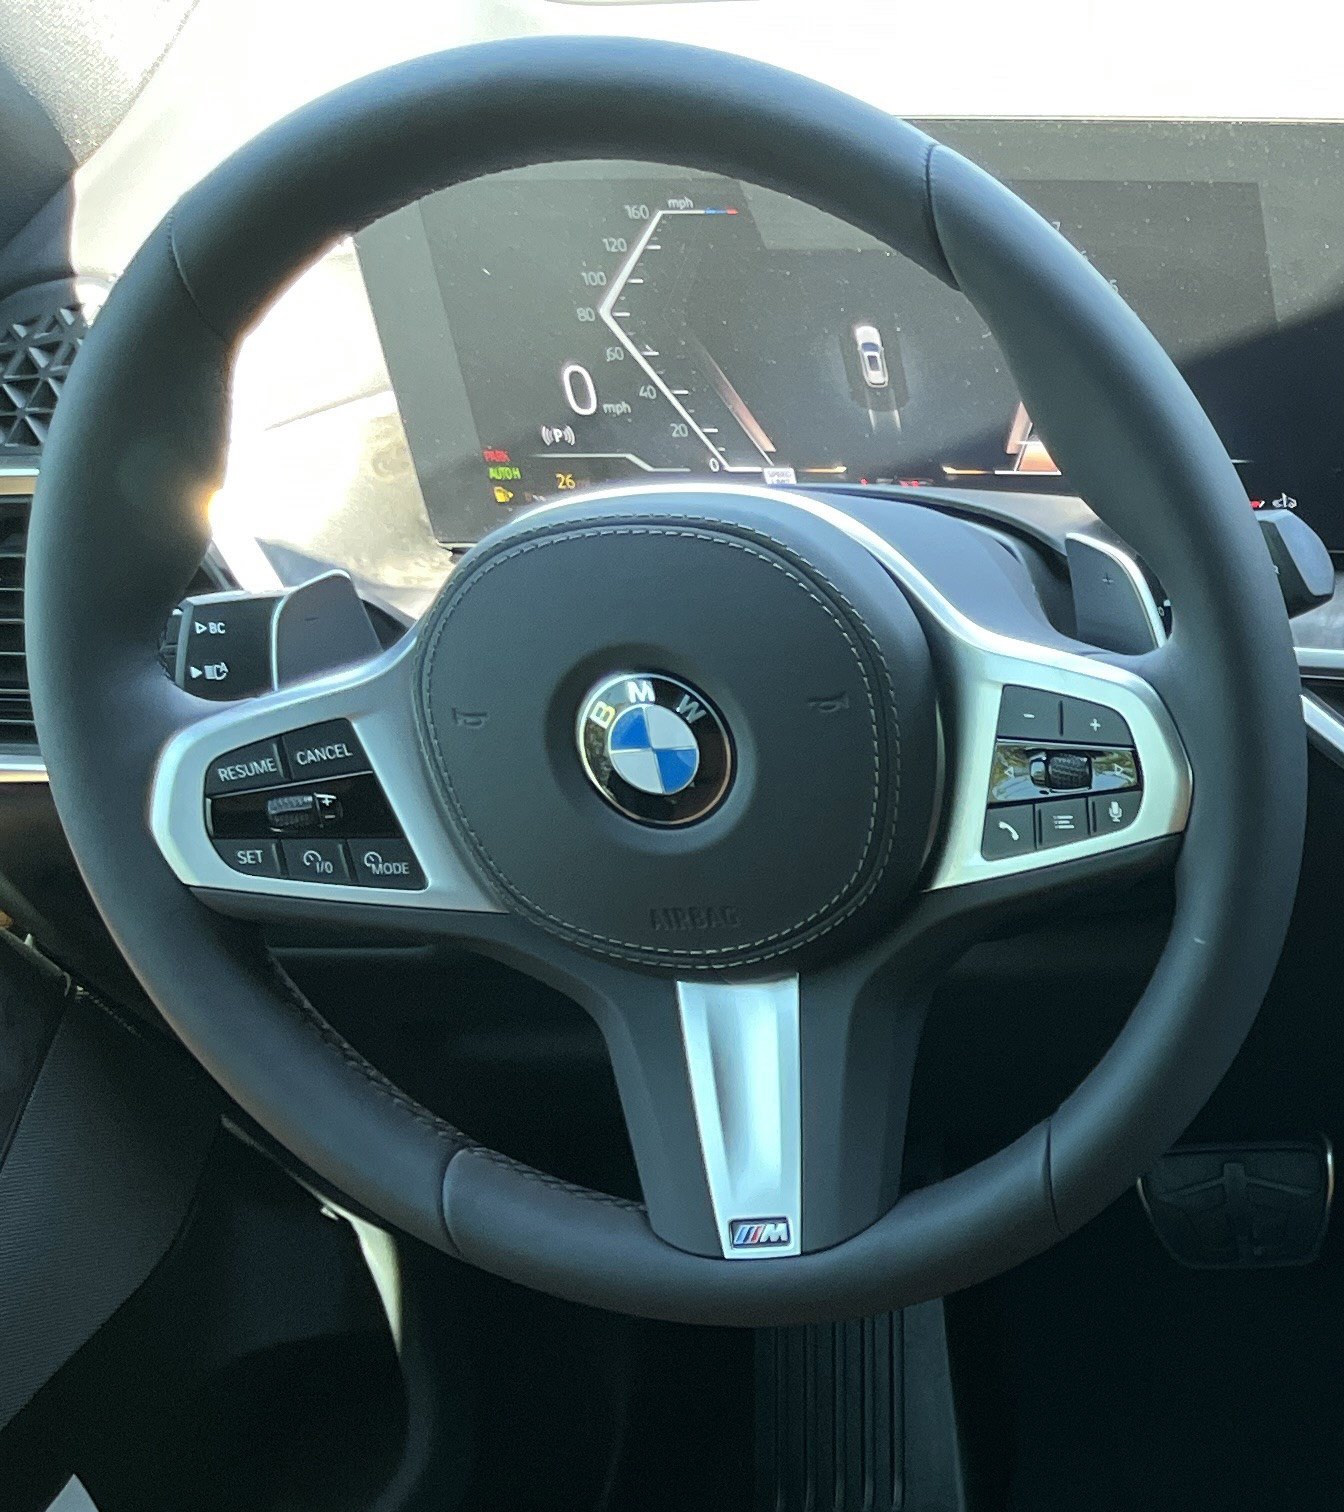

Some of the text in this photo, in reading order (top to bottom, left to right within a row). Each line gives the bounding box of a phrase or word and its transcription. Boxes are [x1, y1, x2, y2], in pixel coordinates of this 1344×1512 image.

[668, 196, 693, 209] mph
[624, 204, 649, 219] 160
[602, 238, 627, 252] 120
[581, 271, 607, 286] 100
[576, 307, 595, 321] 80
[606, 347, 624, 361] 60
[562, 364, 598, 416] 0
[639, 385, 657, 400] 40
[603, 402, 632, 415] mph
[670, 423, 689, 438] 20
[709, 458, 719, 473] 0
[555, 473, 576, 490] 26
[209, 622, 226, 634] BC
[589, 679, 705, 730] BMW
[296, 743, 353, 766] CANCEL
[217, 757, 278, 782] RESUME
[236, 849, 264, 865] SET
[371, 862, 410, 876] MODE
[650, 905, 741, 933] AIRBAG
